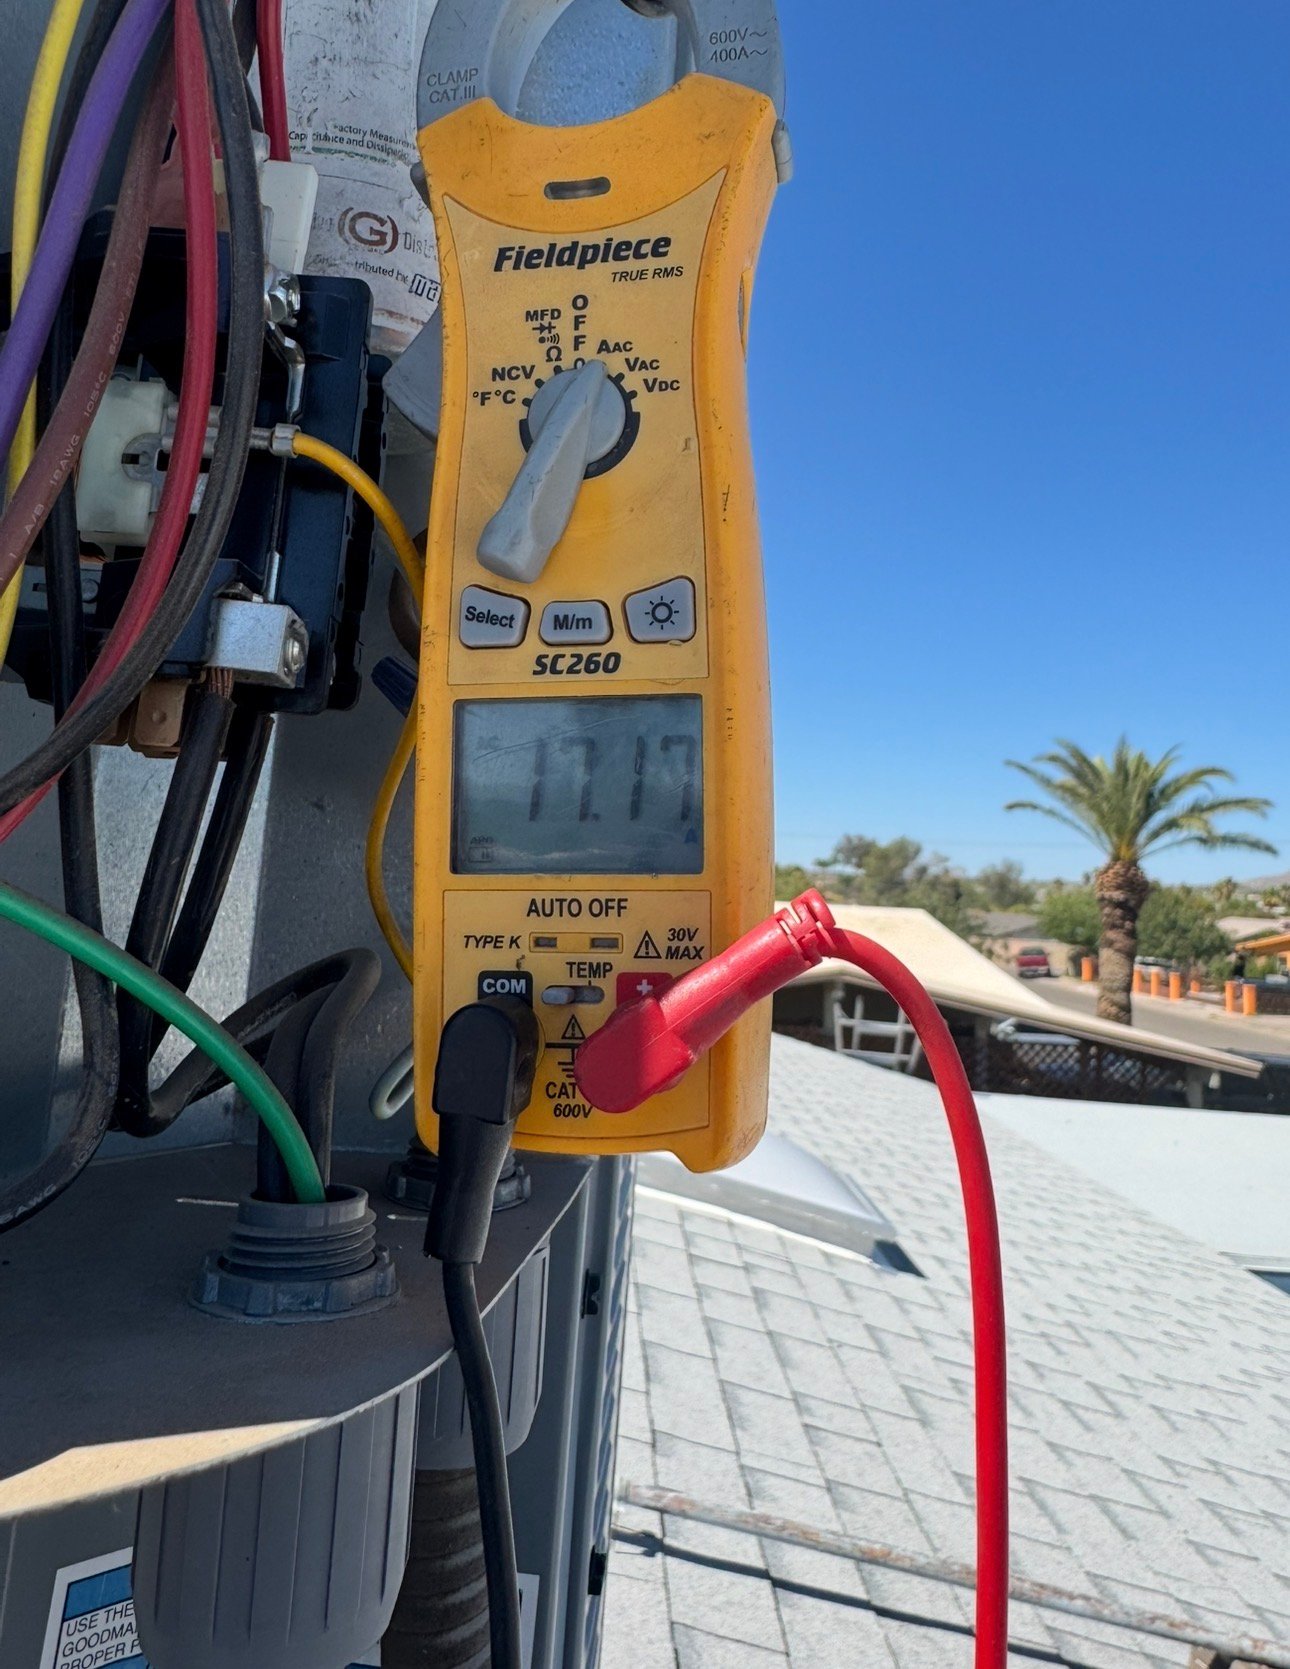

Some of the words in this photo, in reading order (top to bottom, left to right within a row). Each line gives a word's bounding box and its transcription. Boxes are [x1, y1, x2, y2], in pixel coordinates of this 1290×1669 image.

[427, 68, 478, 87] CLAMP
[494, 236, 672, 272] Fieldpiece
[611, 269, 649, 283] TRUE
[652, 266, 684, 280] RMS
[525, 309, 562, 322] MFD
[491, 365, 535, 382] NCV
[465, 606, 515, 628] Select
[553, 614, 593, 630] M/m
[532, 652, 621, 676] SC260
[526, 899, 583, 917] AUTO
[588, 898, 628, 917] OFF
[463, 935, 504, 949] TYPE
[509, 935, 522, 949] K
[667, 927, 699, 942] 30V
[665, 945, 705, 960] MAX
[566, 962, 613, 979] TEMP
[482, 978, 527, 994] COM
[545, 1082, 577, 1099] CAT
[553, 1103, 593, 1118] 600V
[66, 1613, 99, 1637] USE
[104, 1602, 134, 1624] THE
